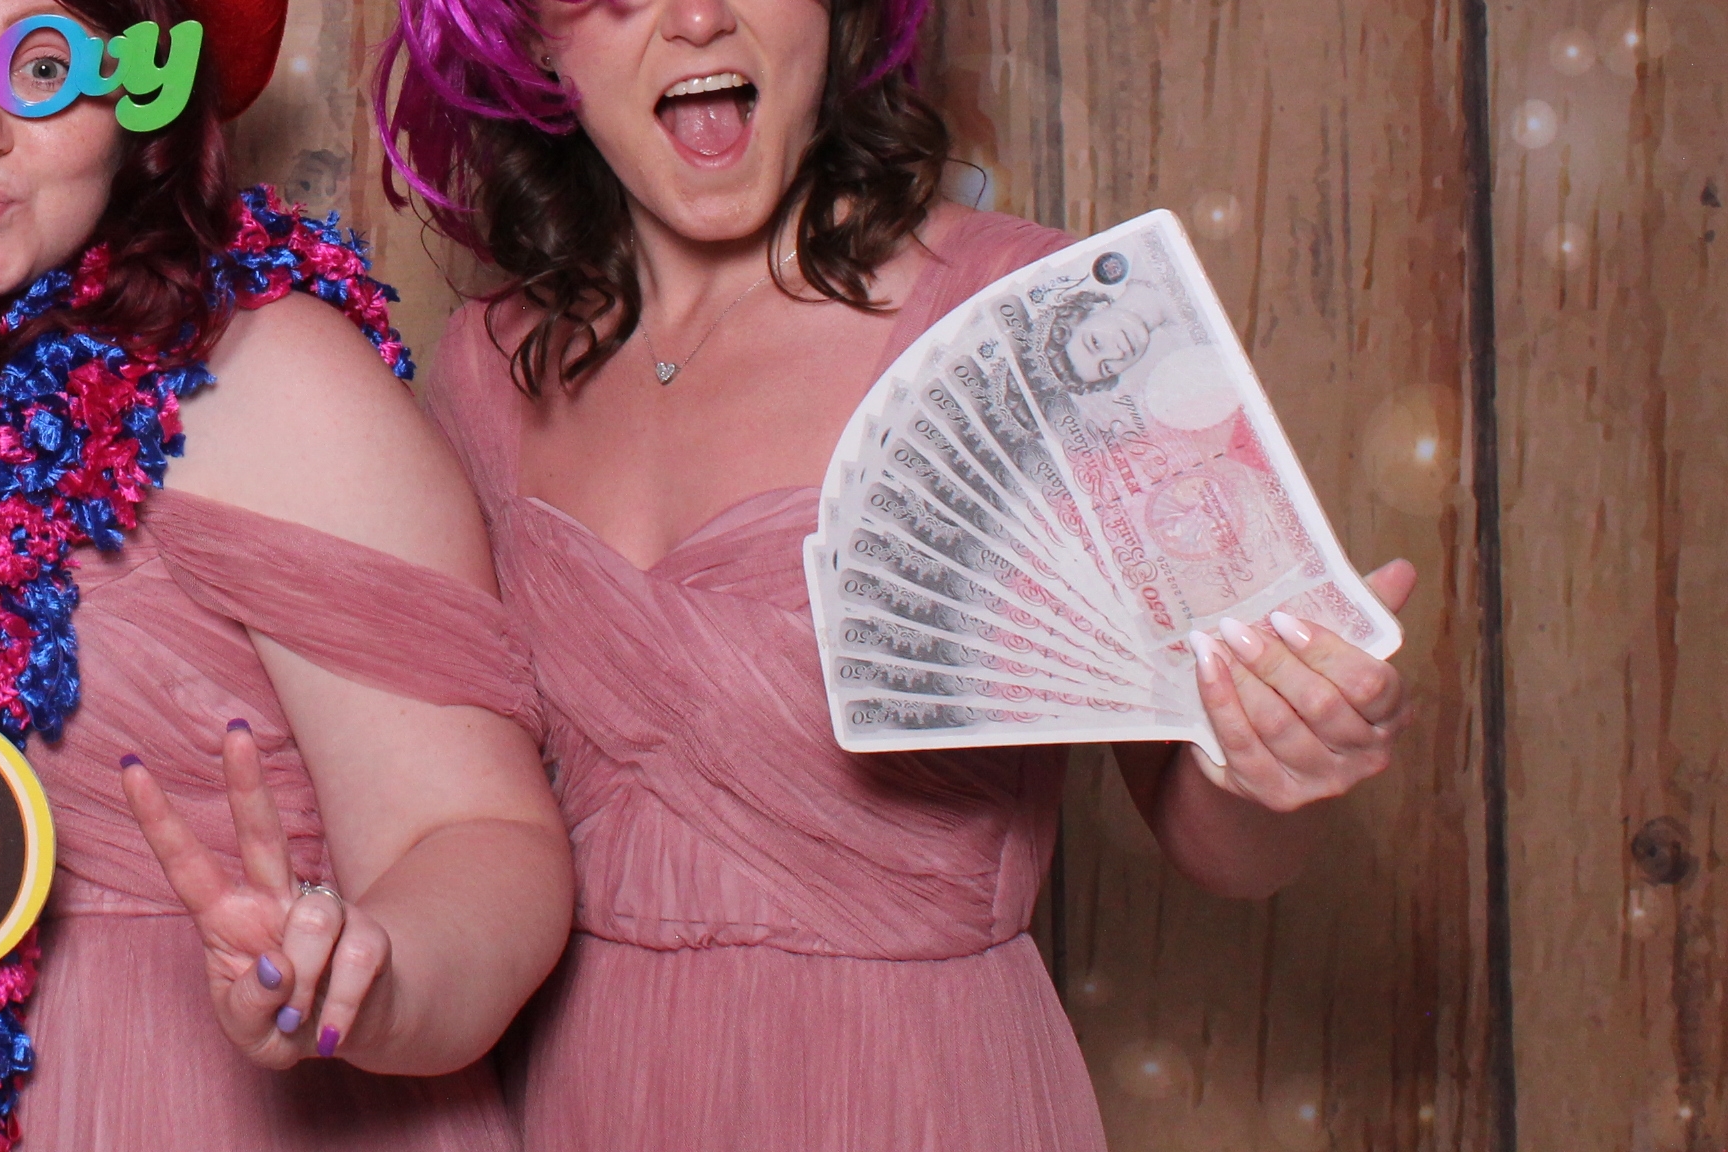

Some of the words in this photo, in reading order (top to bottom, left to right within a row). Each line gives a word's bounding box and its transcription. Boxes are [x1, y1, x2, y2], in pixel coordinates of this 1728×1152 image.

[999, 304, 1033, 345] £50
[953, 365, 991, 401] £50
[928, 388, 970, 423] £50
[914, 419, 957, 452] £50
[894, 448, 941, 478] £50
[1058, 415, 1108, 502] England
[1099, 426, 1143, 497] FIFTY
[870, 493, 915, 520] £50
[854, 539, 900, 563] £50
[1107, 515, 1156, 589] Bank
[844, 579, 891, 600] £50
[1141, 586, 1176, 631] £50
[844, 628, 889, 646] £50
[840, 664, 883, 681] £50
[852, 707, 892, 725] £50
